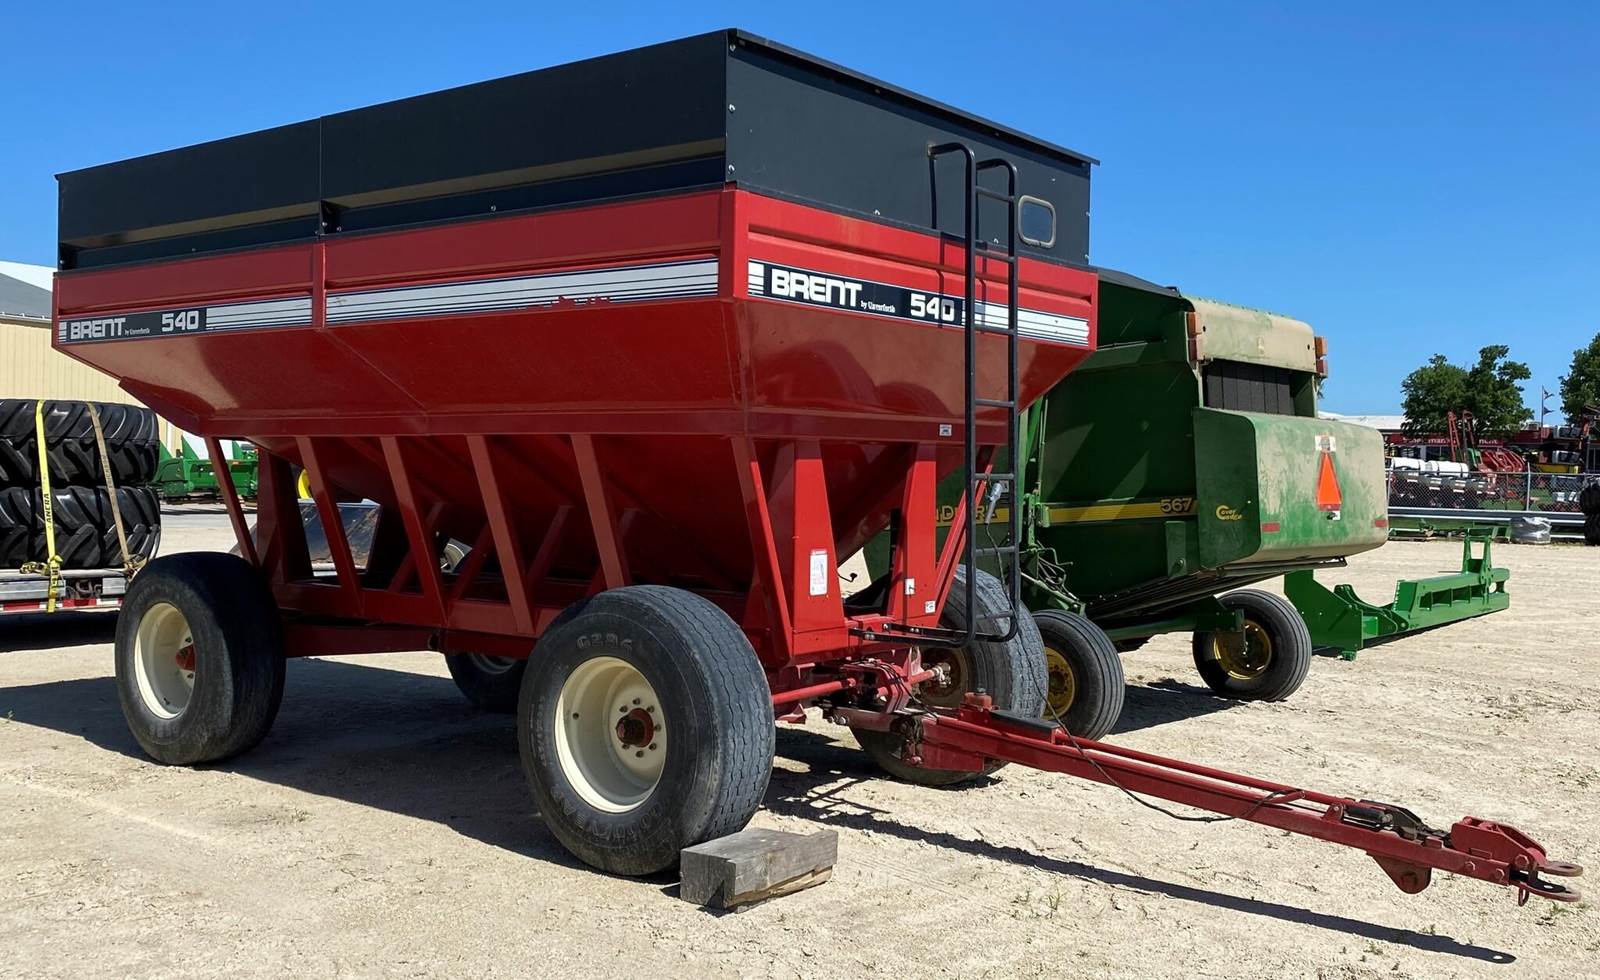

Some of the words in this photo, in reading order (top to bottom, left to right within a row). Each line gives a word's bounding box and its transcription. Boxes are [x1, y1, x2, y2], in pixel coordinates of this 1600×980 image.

[771, 268, 863, 307] BRENT
[910, 293, 955, 322] 540
[70, 317, 126, 340] BRENT
[161, 310, 199, 332] 540
[43, 493, 54, 523] ANCRA
[1160, 498, 1193, 513] 567
